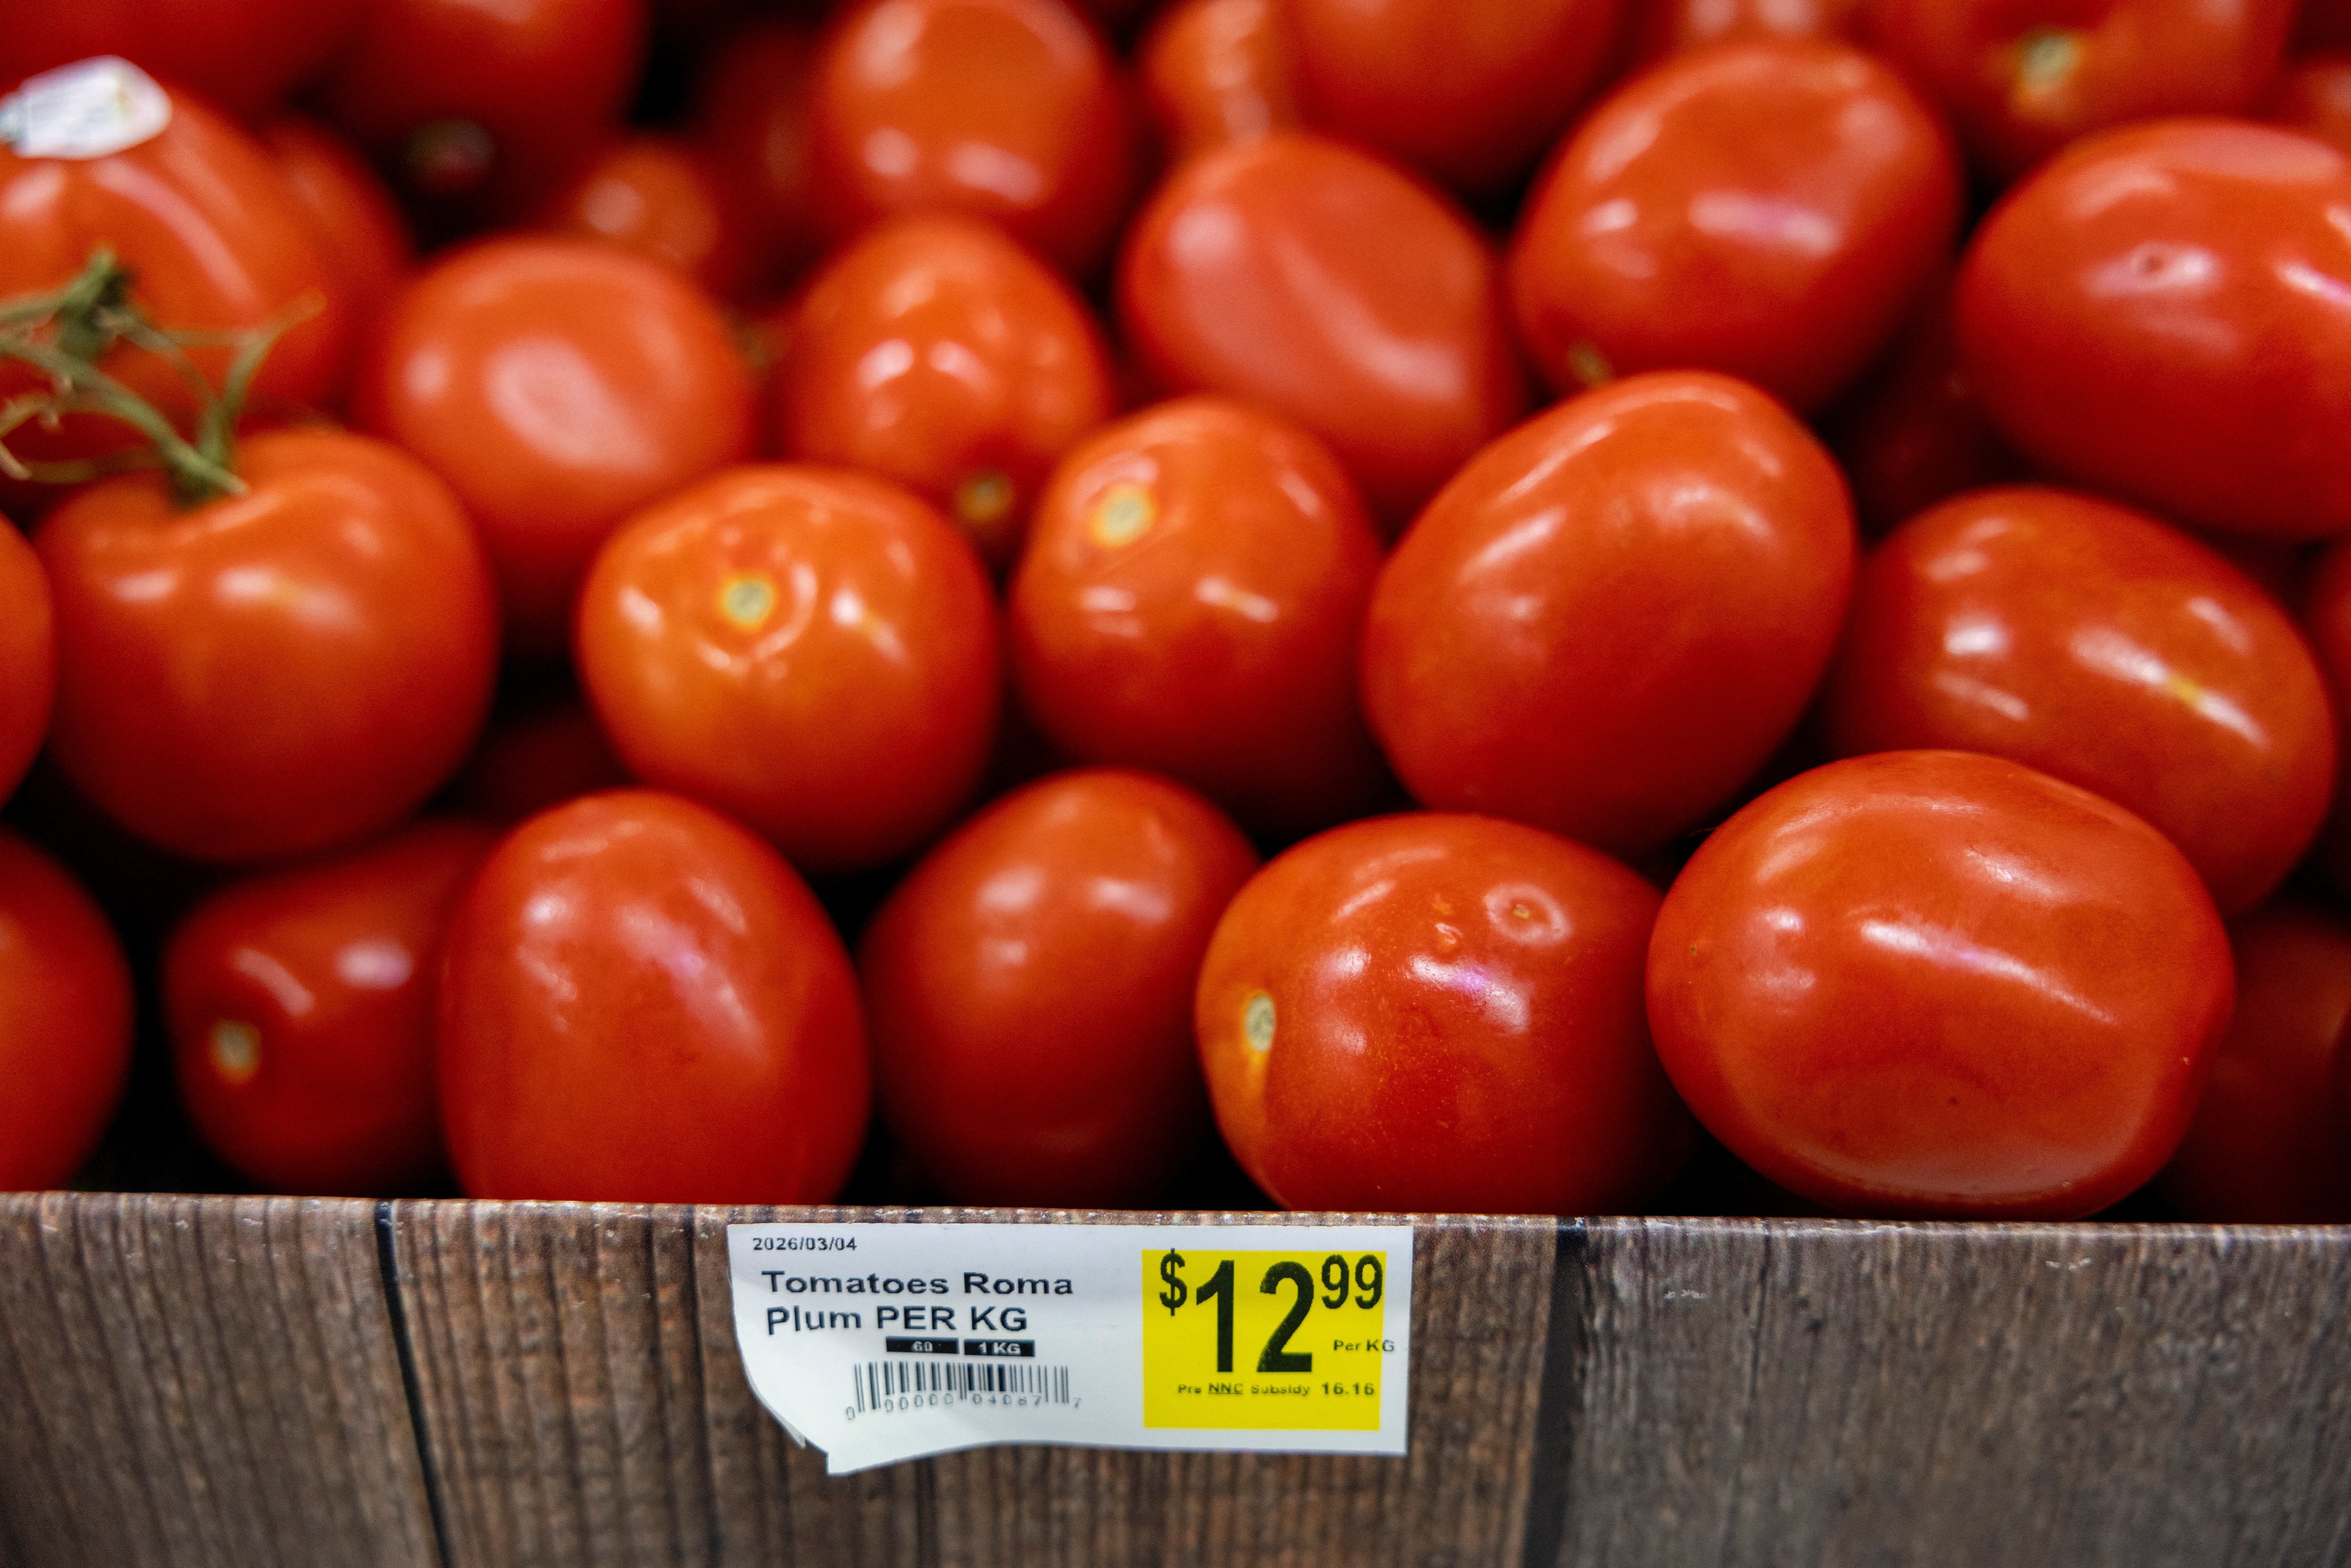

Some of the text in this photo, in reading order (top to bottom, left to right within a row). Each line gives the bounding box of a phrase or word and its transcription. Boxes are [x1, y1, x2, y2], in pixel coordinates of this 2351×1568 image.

[752, 1237, 858, 1251] 2026/03/04
[761, 1270, 1073, 1295] Tomatoes Roma
[766, 1305, 1028, 1336] Plum PER KG
[979, 1342, 1022, 1355] 1 KG
[1333, 1339, 1395, 1352] Per KG
[1177, 1381, 1375, 1397] Pre NNC Subsidy 16.16
